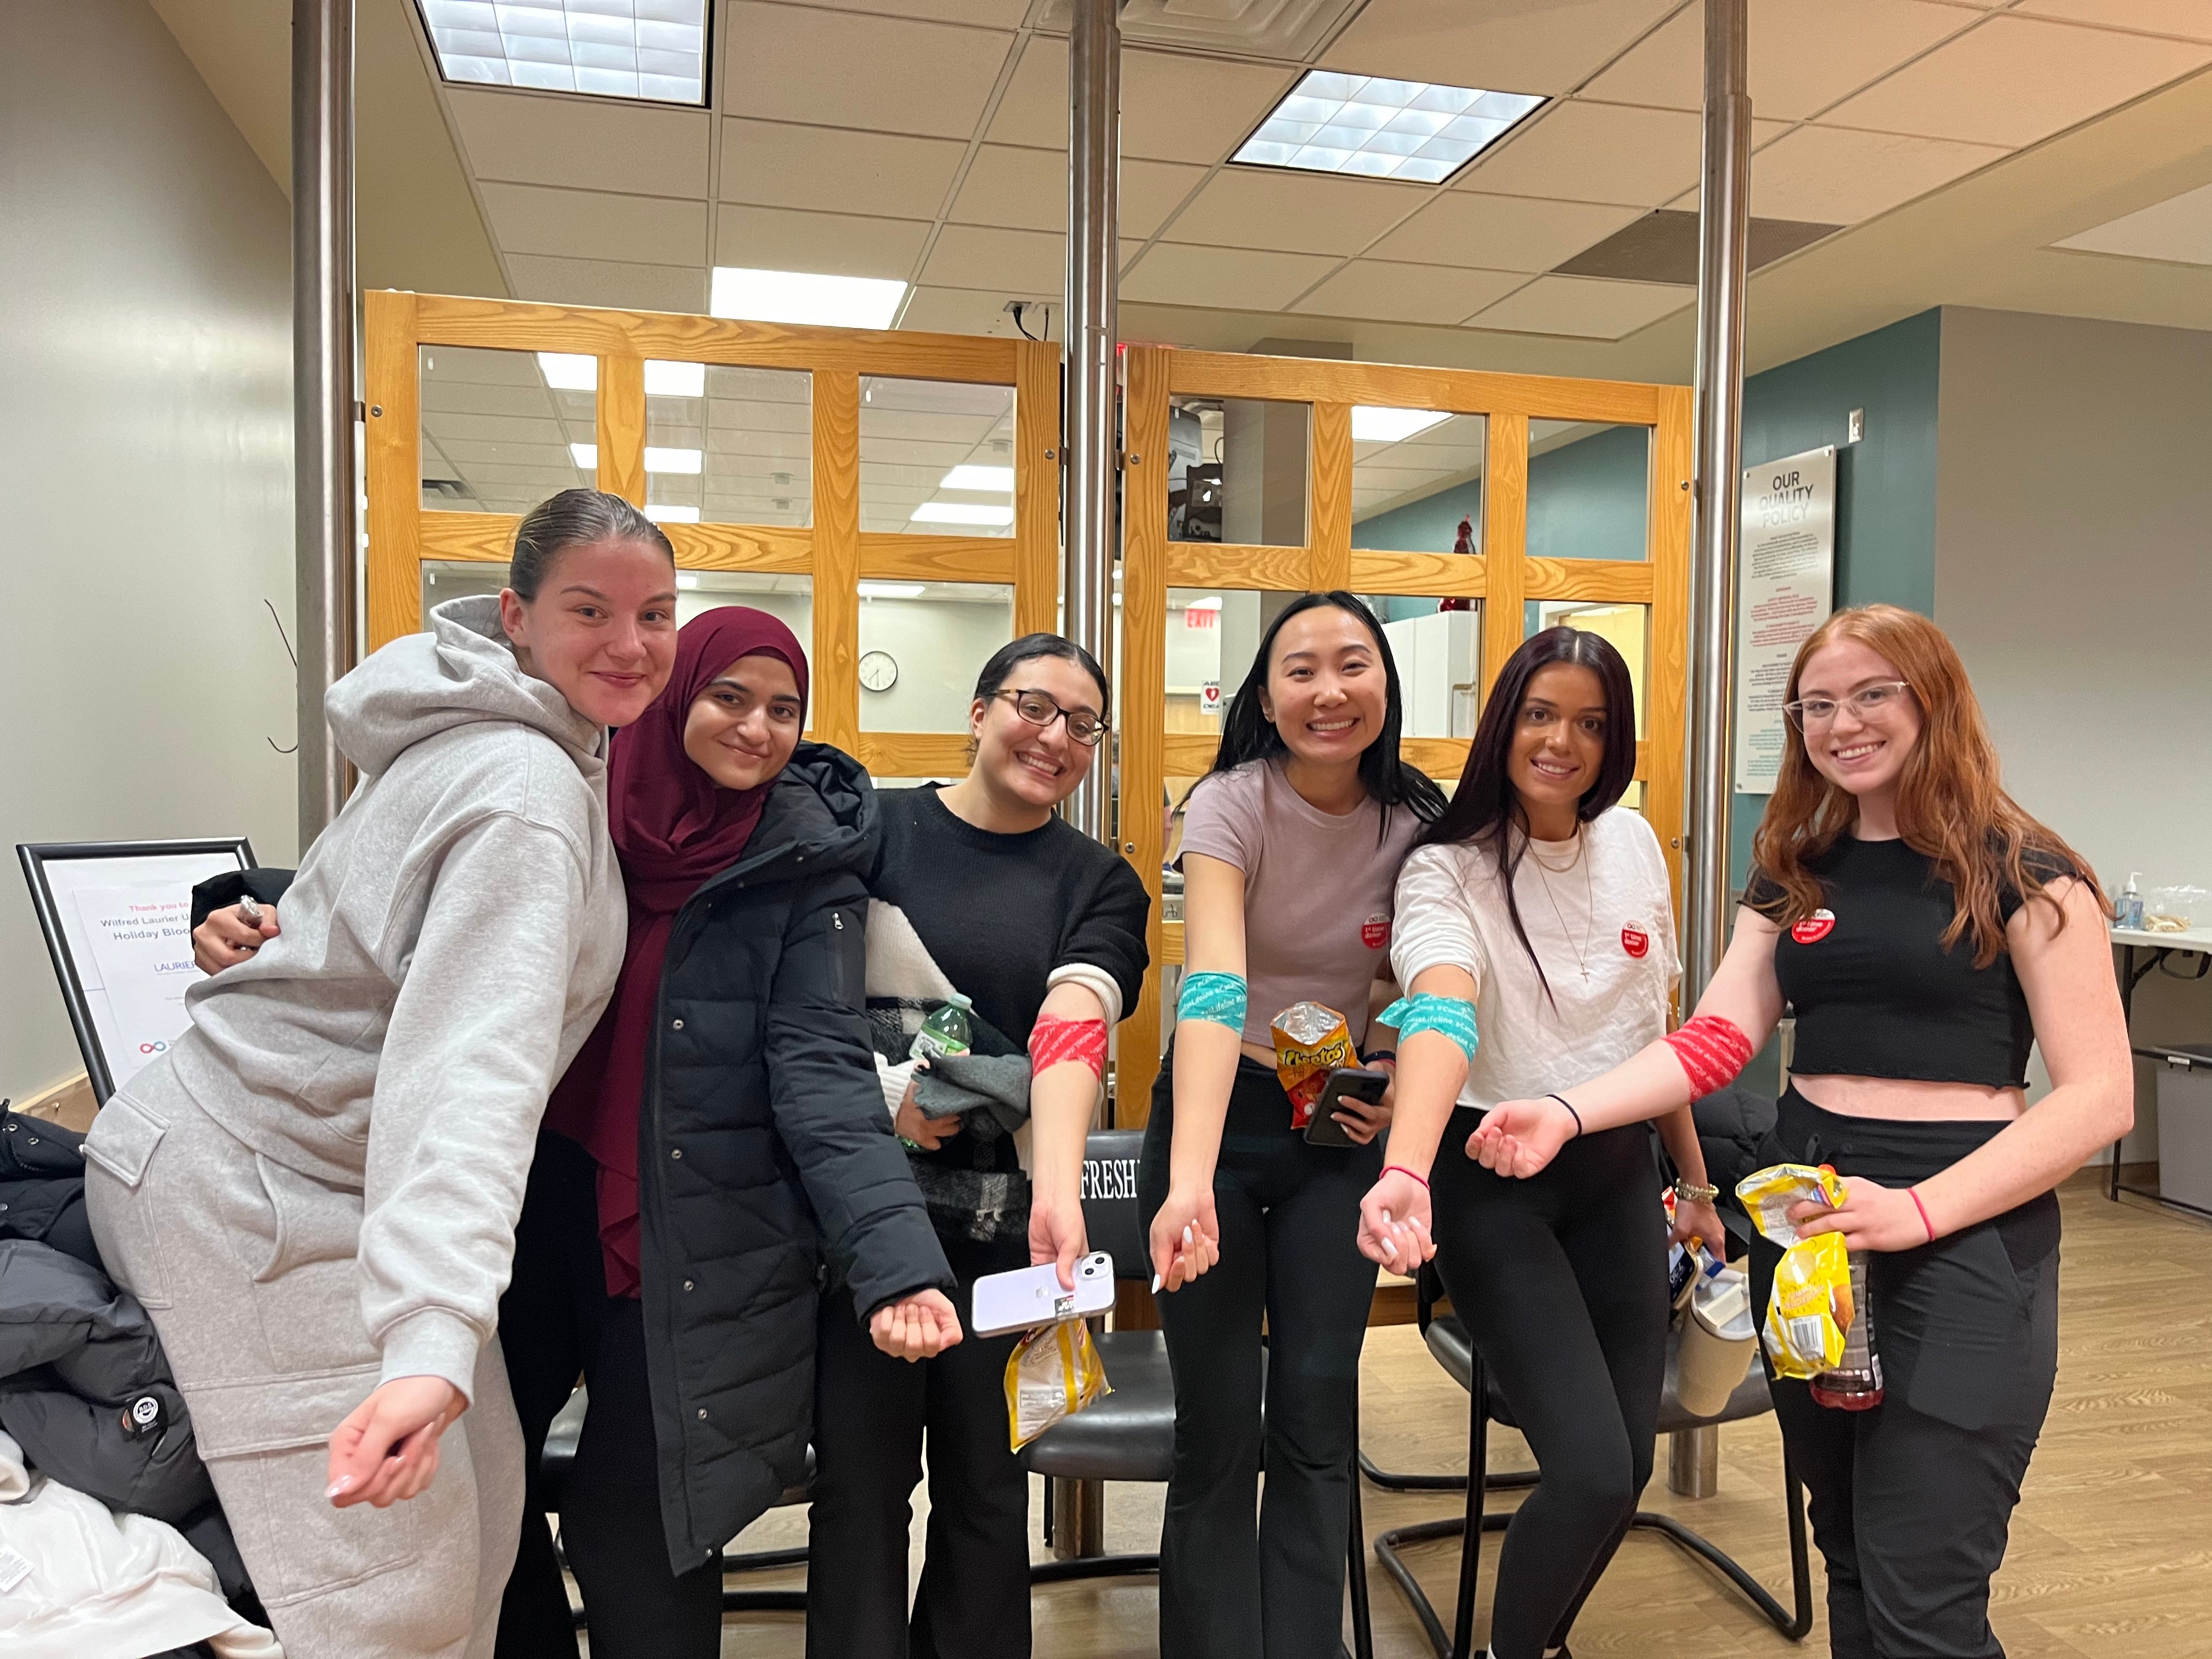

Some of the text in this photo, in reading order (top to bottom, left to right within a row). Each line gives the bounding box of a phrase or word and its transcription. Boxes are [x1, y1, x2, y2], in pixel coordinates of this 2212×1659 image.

[1773, 471, 1799, 490] OUR
[1759, 484, 1813, 511] QUALITY
[1763, 502, 1809, 528] POLICY
[1187, 609, 1215, 628] EXIT
[100, 918, 139, 927] Wilfred
[142, 915, 178, 924] Laurier
[113, 931, 159, 940] Holiday
[1284, 1041, 1344, 1066] Cheetos
[1080, 1159, 1140, 1199] FRESH
